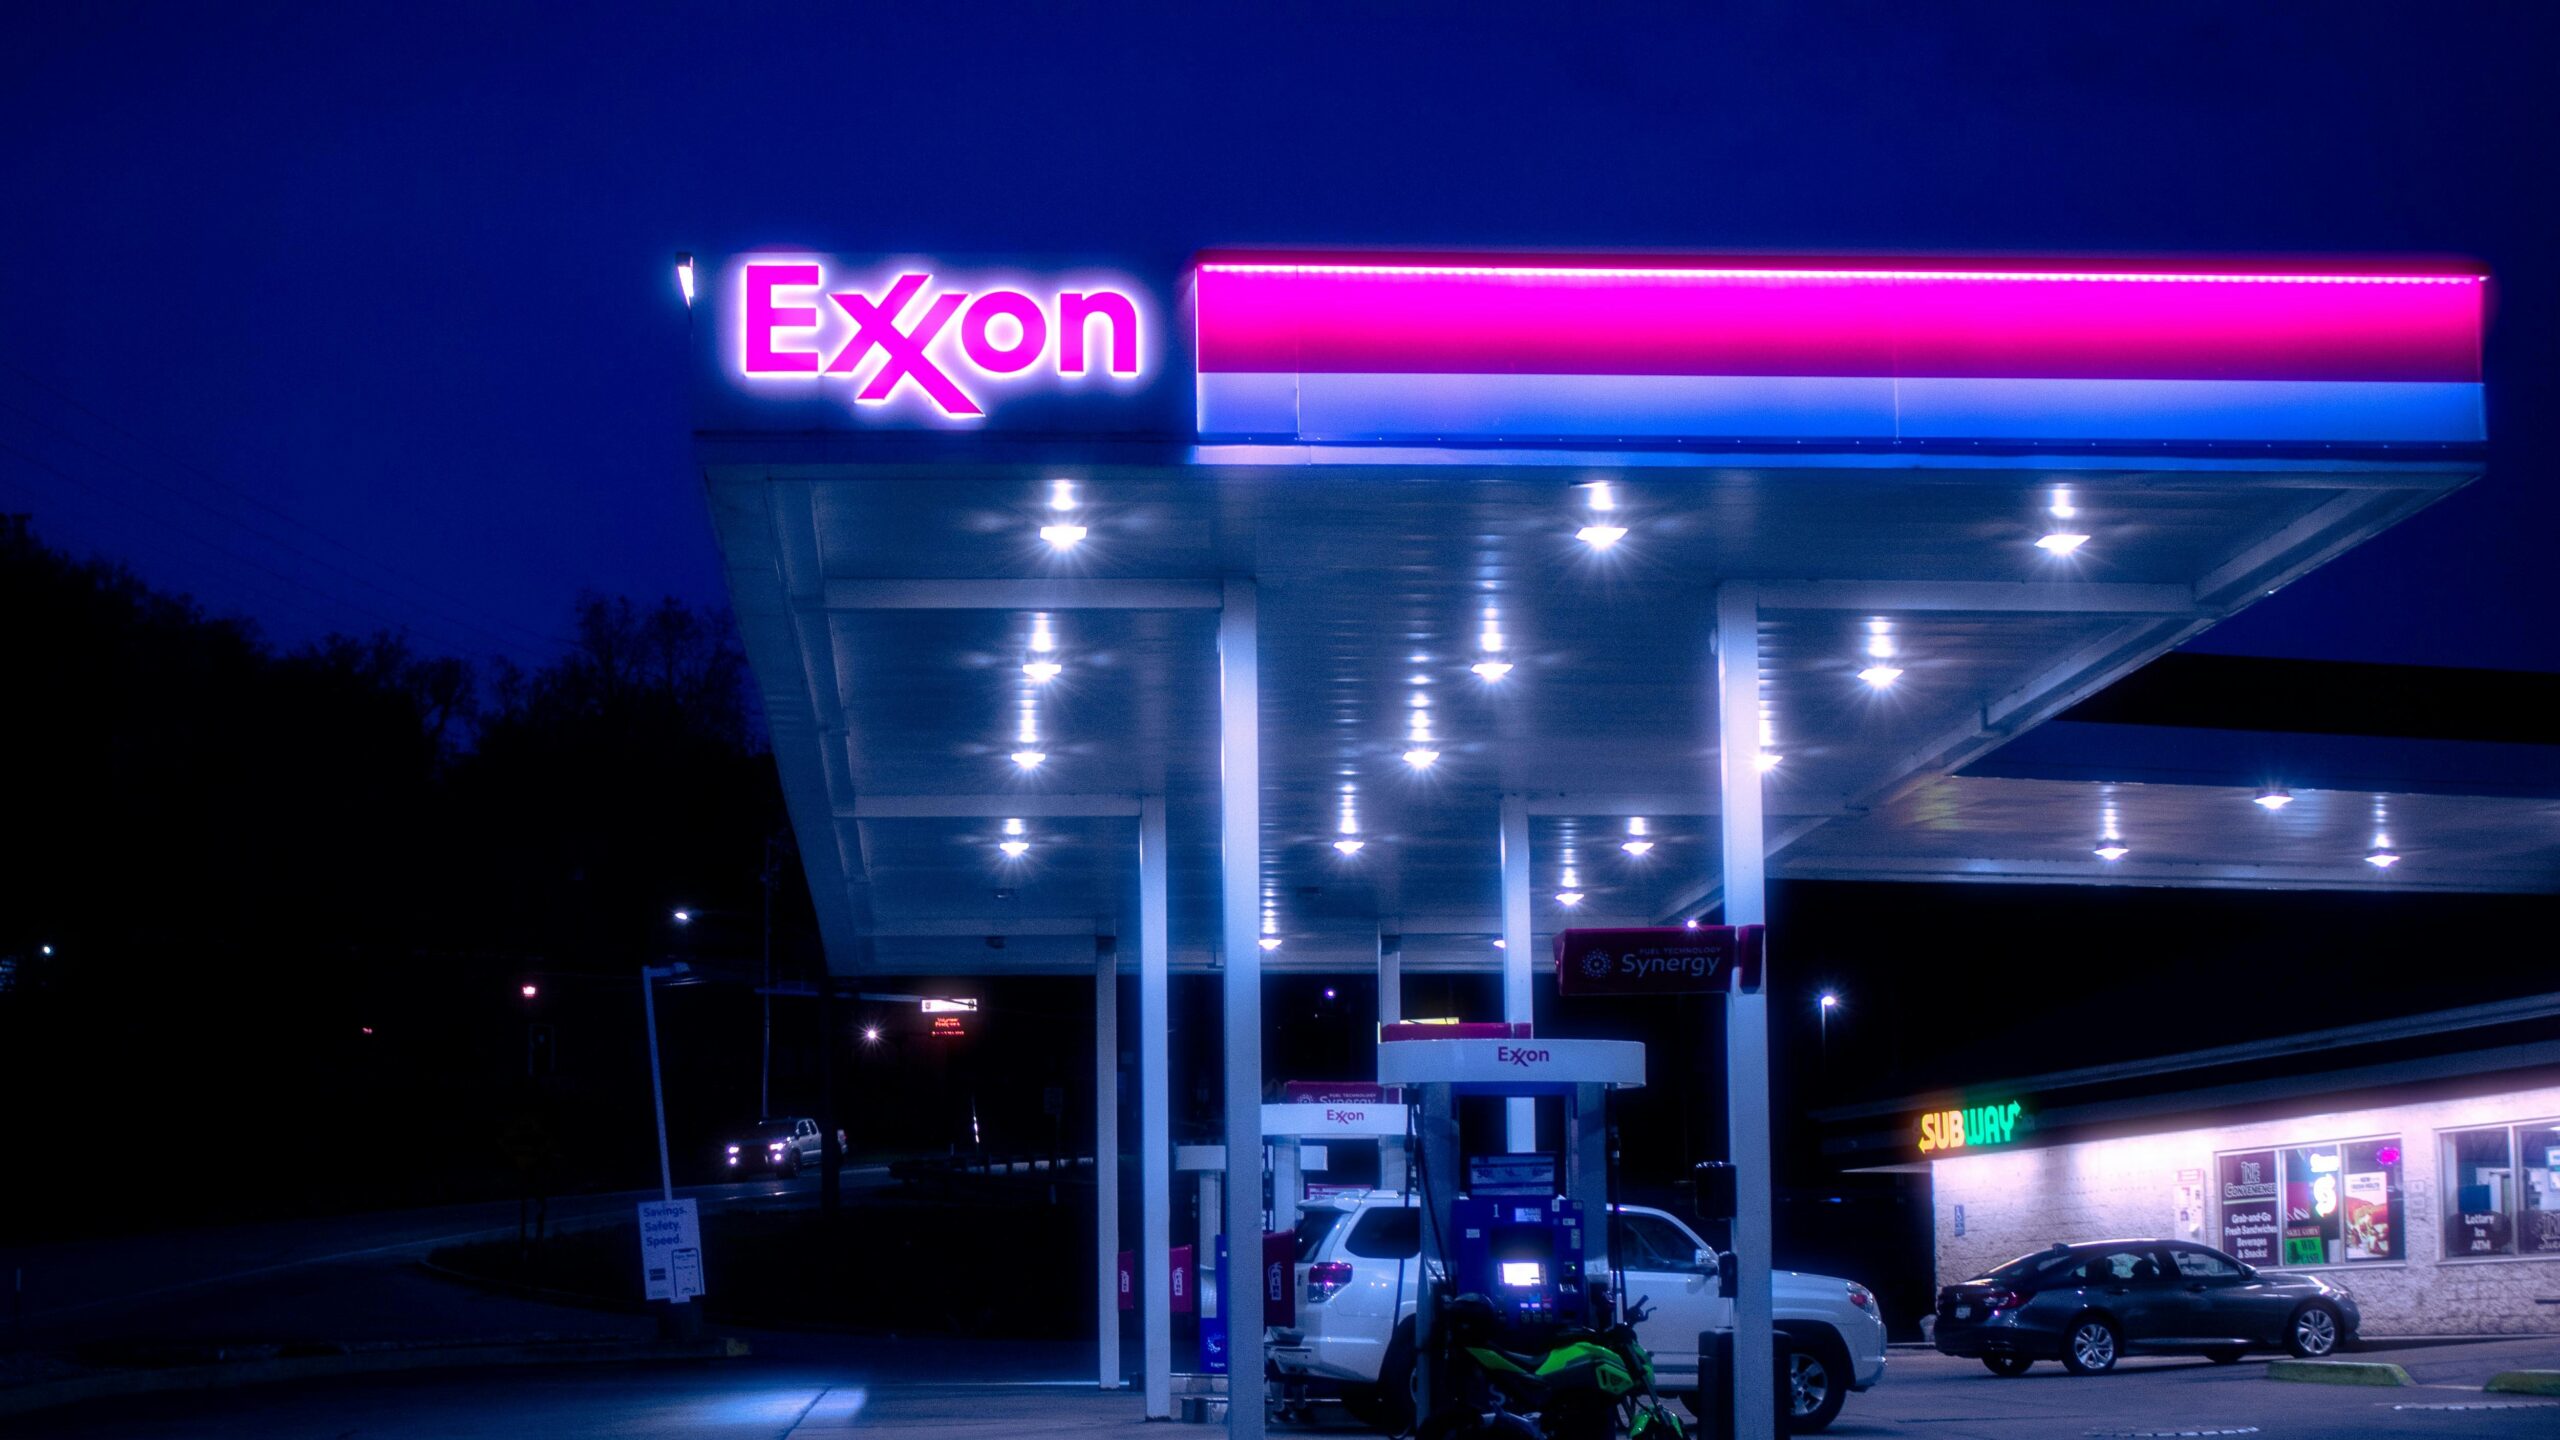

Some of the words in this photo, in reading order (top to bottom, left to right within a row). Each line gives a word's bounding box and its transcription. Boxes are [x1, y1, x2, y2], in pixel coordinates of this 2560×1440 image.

[745, 264, 1138, 415] Exxon
[1620, 953, 1721, 978] Synergy
[1498, 1046, 1550, 1067] Exxon
[1326, 1109, 1365, 1124] Exxon
[1918, 1100, 2021, 1153] SUBWAY
[643, 1206, 687, 1218] Savings.
[1493, 1203, 1500, 1218] 1
[2231, 1212, 2272, 1224] Grab-and-Go
[2464, 1214, 2494, 1225] Lottery
[2224, 1227, 2241, 1236] Fresh
[2241, 1224, 2278, 1235] Sandwiches
[2236, 1237, 2268, 1247] Beverages
[2471, 1239, 2492, 1251] ATM
